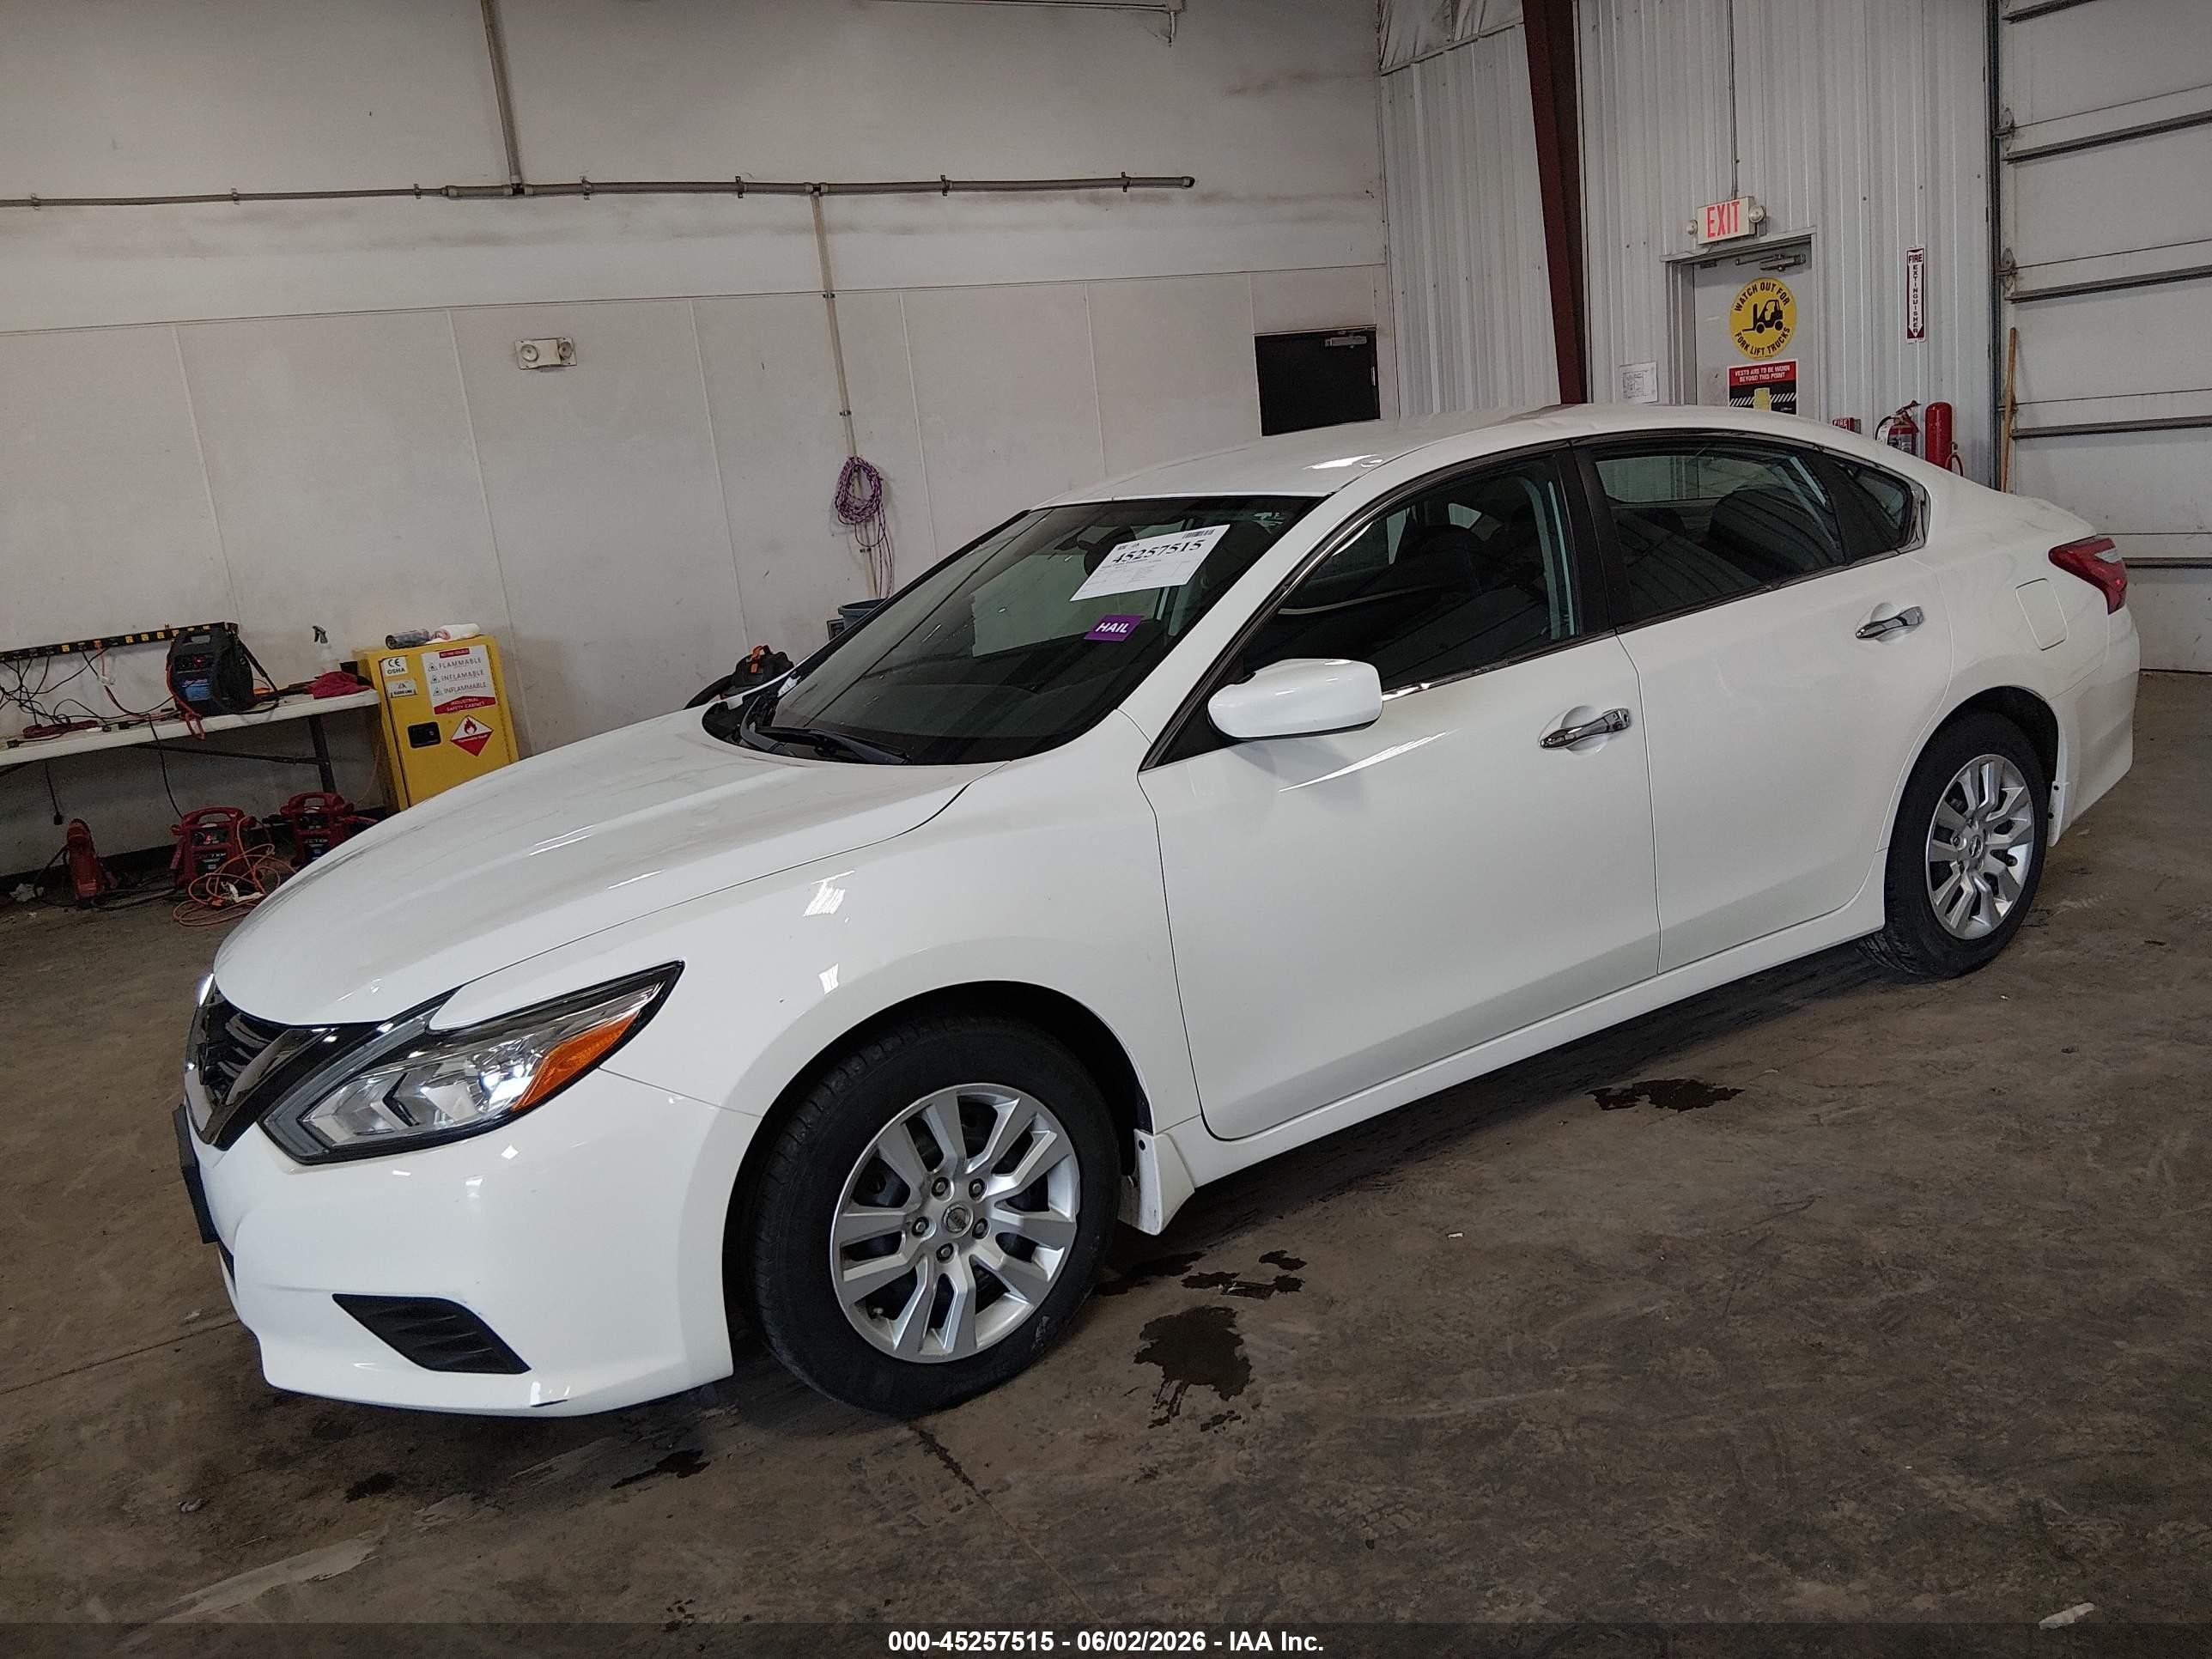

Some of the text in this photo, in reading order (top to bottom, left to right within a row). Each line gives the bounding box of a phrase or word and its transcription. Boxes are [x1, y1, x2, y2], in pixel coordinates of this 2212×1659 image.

[1707, 201, 1740, 238] EXIT
[1908, 253, 1923, 264] FIRE
[1735, 282, 1790, 312] WATCH OUT FOR
[1735, 327, 1790, 356] FORK LIFT TRUCKS
[1113, 538, 1206, 563] 45257515
[1095, 623, 1129, 633] HAIL
[439, 657, 482, 669] FLAMMABLE
[441, 669, 484, 681] INFLAMABLE
[444, 681, 487, 694] INFLAMMABLE
